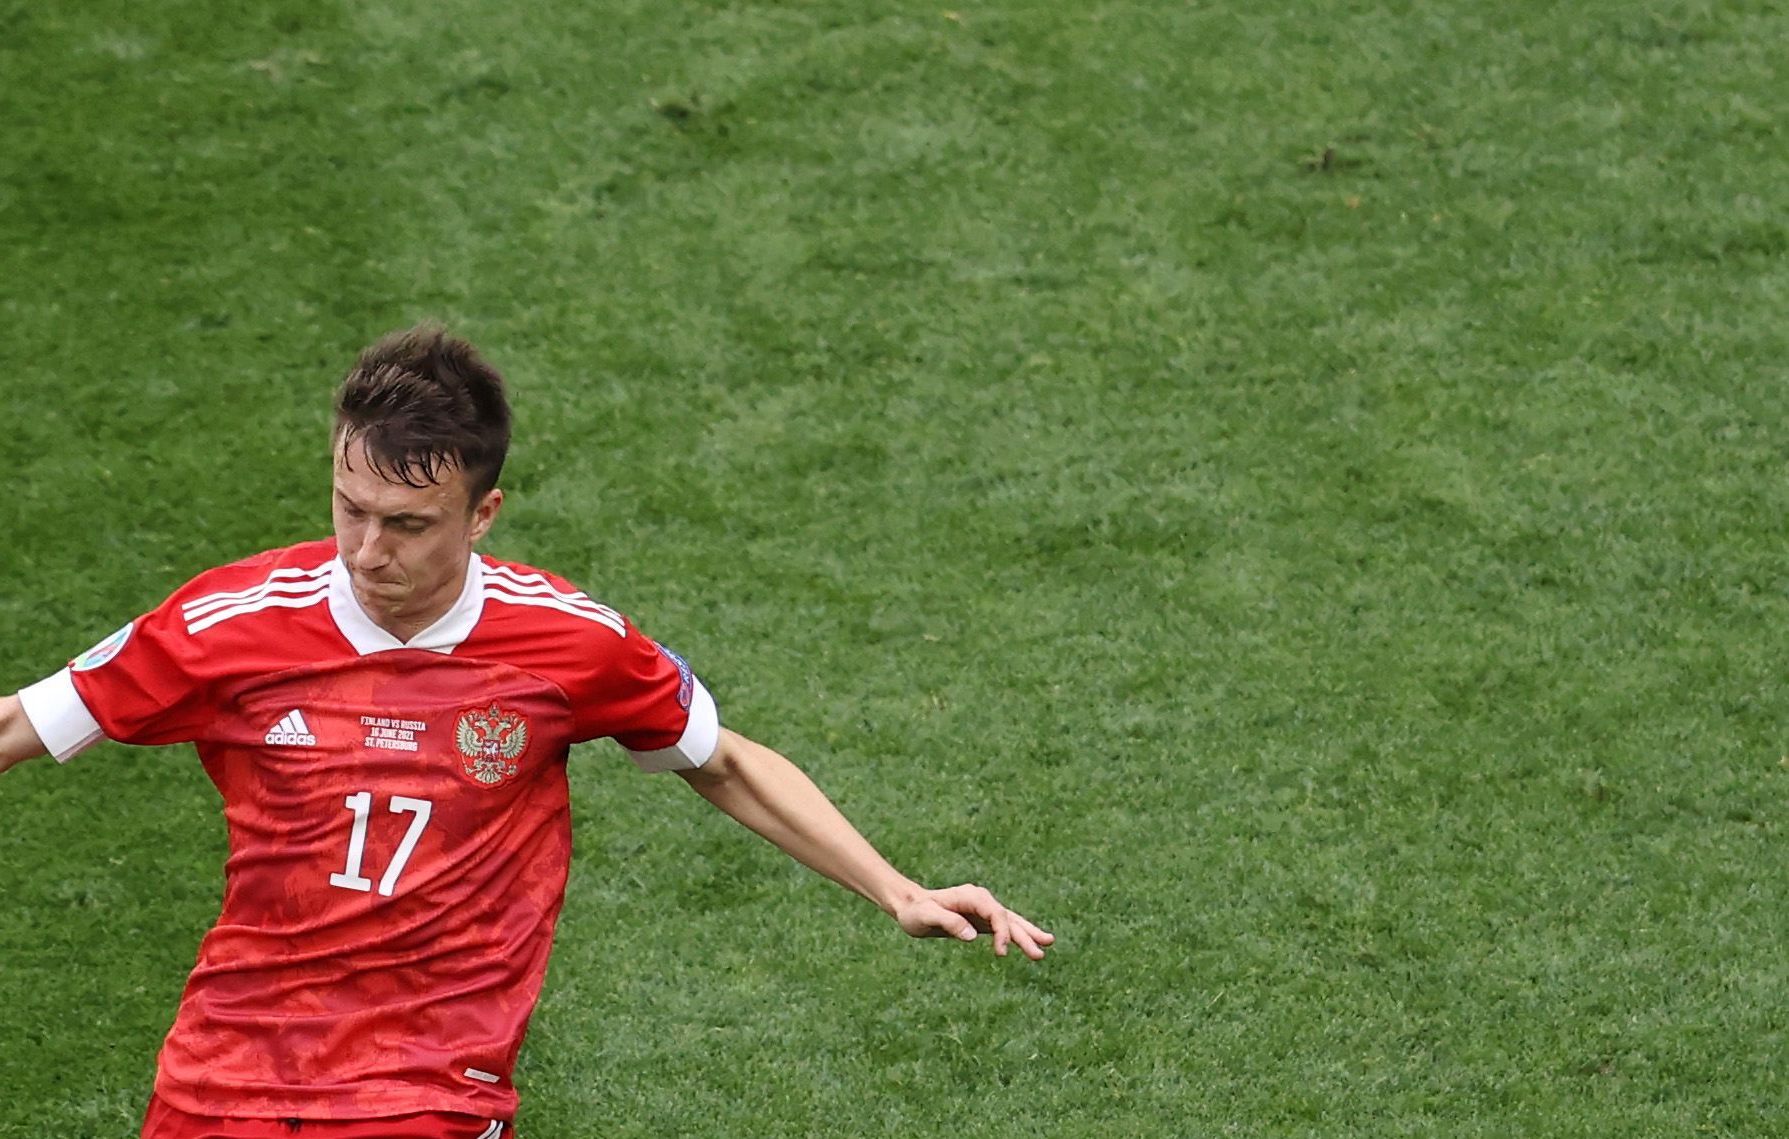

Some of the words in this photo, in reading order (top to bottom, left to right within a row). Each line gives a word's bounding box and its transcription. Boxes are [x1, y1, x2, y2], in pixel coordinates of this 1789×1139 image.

[360, 716, 390, 727] FINLAND
[391, 719, 400, 729] VS
[400, 720, 426, 731] RUSSIA
[265, 731, 316, 746] adidas
[329, 791, 433, 897] 17
